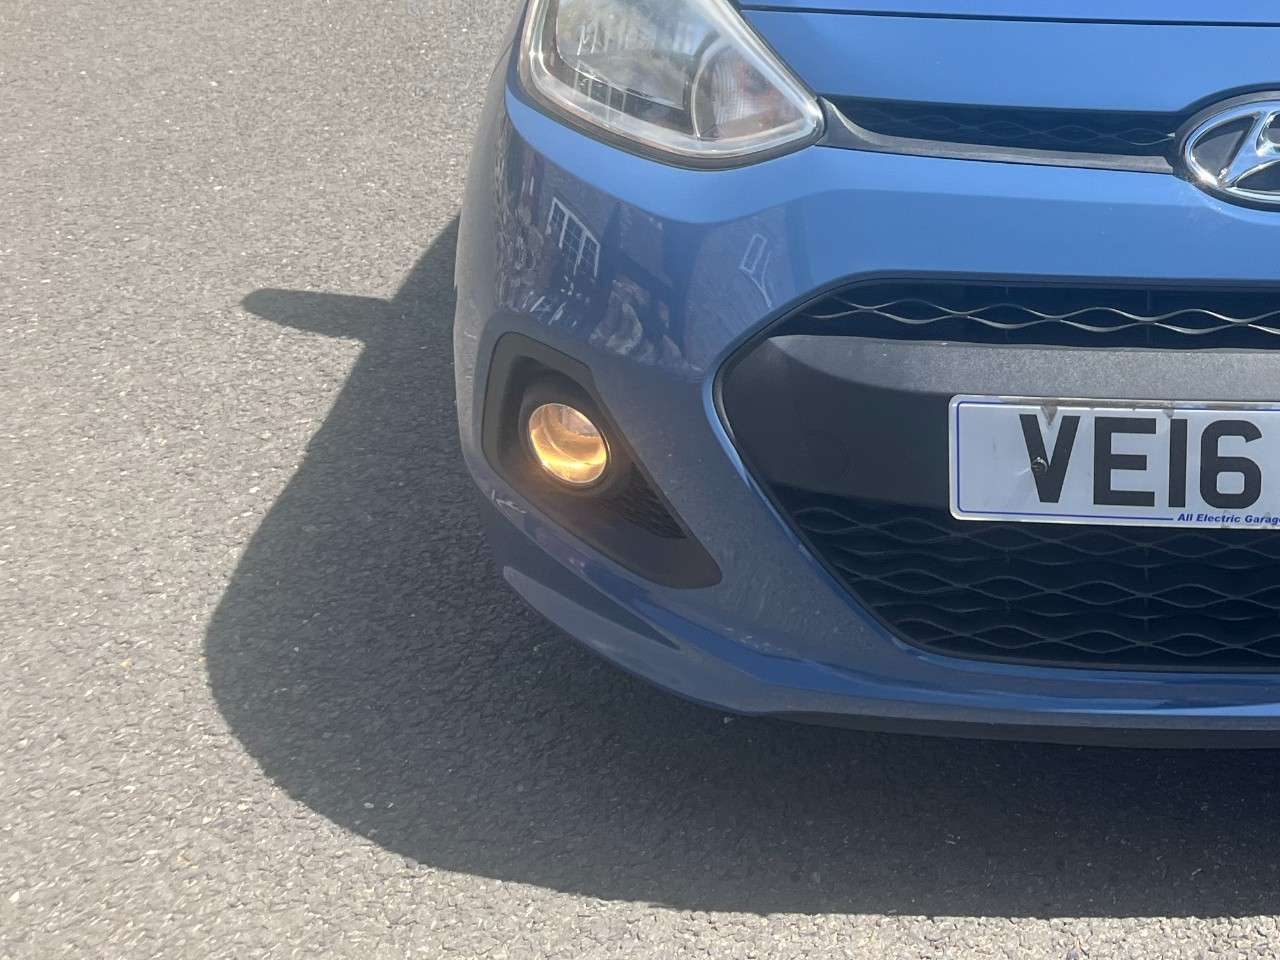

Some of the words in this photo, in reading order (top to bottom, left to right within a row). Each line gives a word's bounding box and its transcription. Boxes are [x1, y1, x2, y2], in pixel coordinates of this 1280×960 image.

[1018, 413, 1263, 509] VE16
[1177, 513, 1193, 522] All
[1196, 513, 1241, 523] Electric
